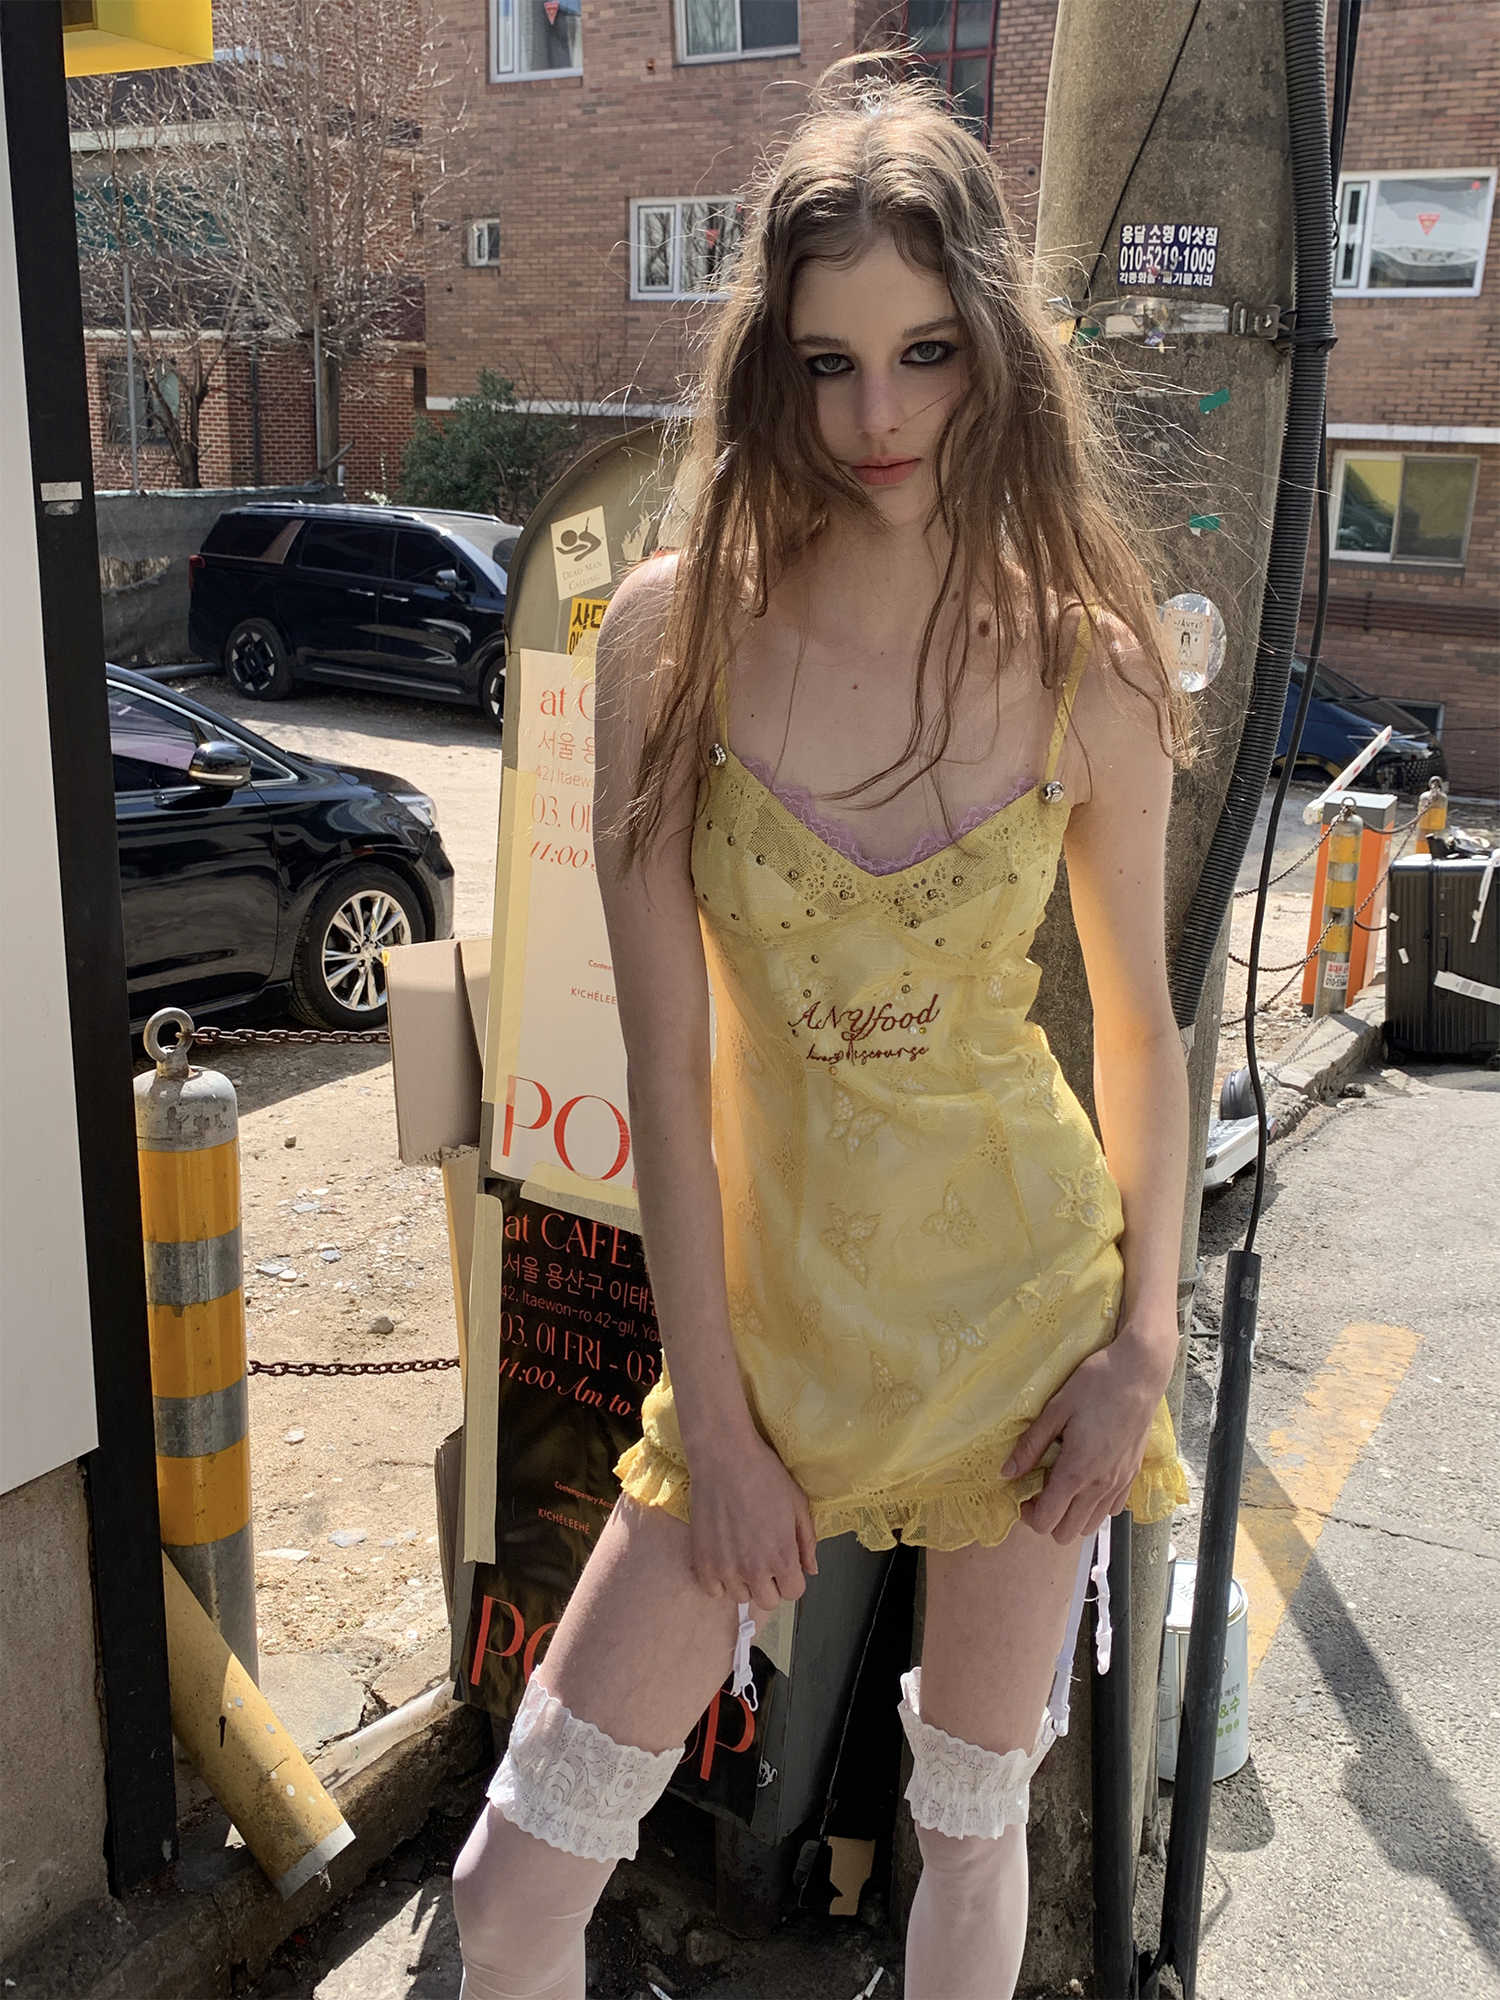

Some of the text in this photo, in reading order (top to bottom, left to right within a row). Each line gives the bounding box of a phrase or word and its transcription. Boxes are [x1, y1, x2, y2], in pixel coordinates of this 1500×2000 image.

[1122, 224, 1218, 246] 용달 소형 이삿짐
[540, 687, 566, 717] at
[538, 730, 576, 761] 서울
[501, 1074, 637, 1189] PO
[504, 1213, 530, 1243] at
[504, 1252, 656, 1317] 서울 용산구 이태
[641, 1322, 660, 1342] Yo
[564, 1330, 601, 1370] FRI
[609, 1394, 632, 1416] to
